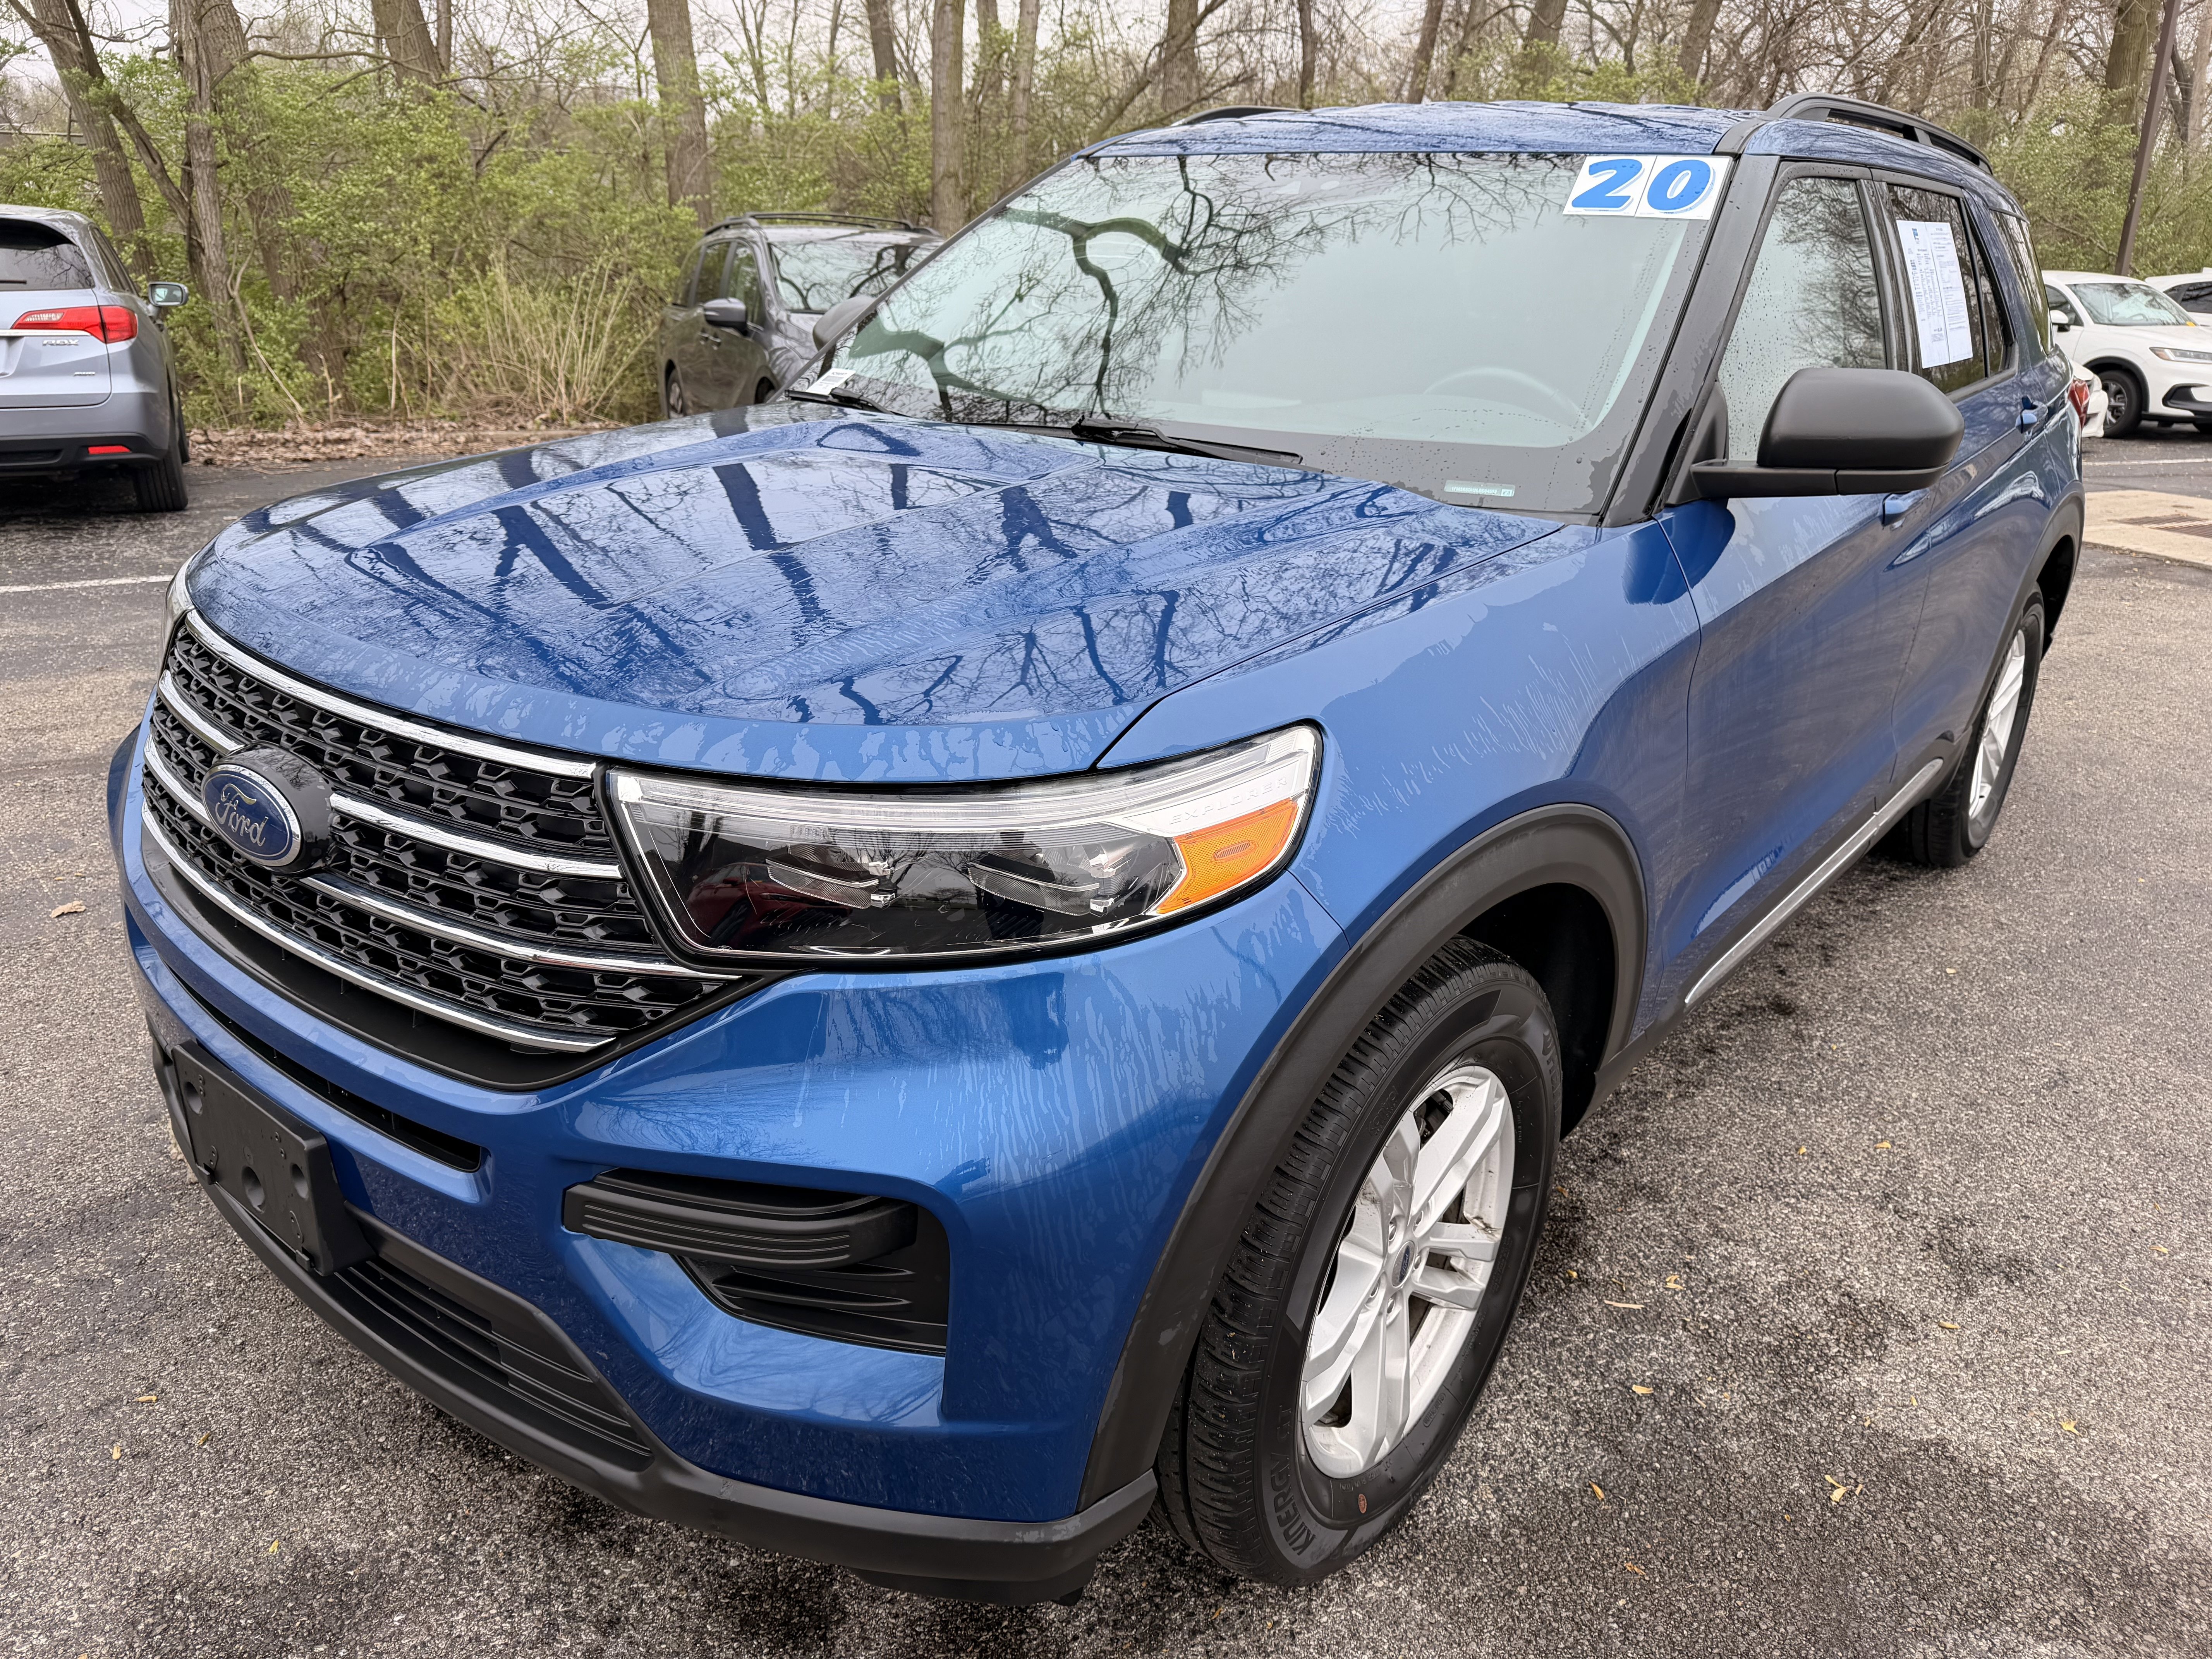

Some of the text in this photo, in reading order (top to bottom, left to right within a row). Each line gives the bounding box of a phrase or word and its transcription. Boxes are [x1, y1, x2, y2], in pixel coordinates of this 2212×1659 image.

[1571, 159, 1714, 213] 20
[215, 783, 268, 847] Ford
[1168, 777, 1288, 825] EXPLORER
[1271, 1452, 1316, 1556] KINERGY
